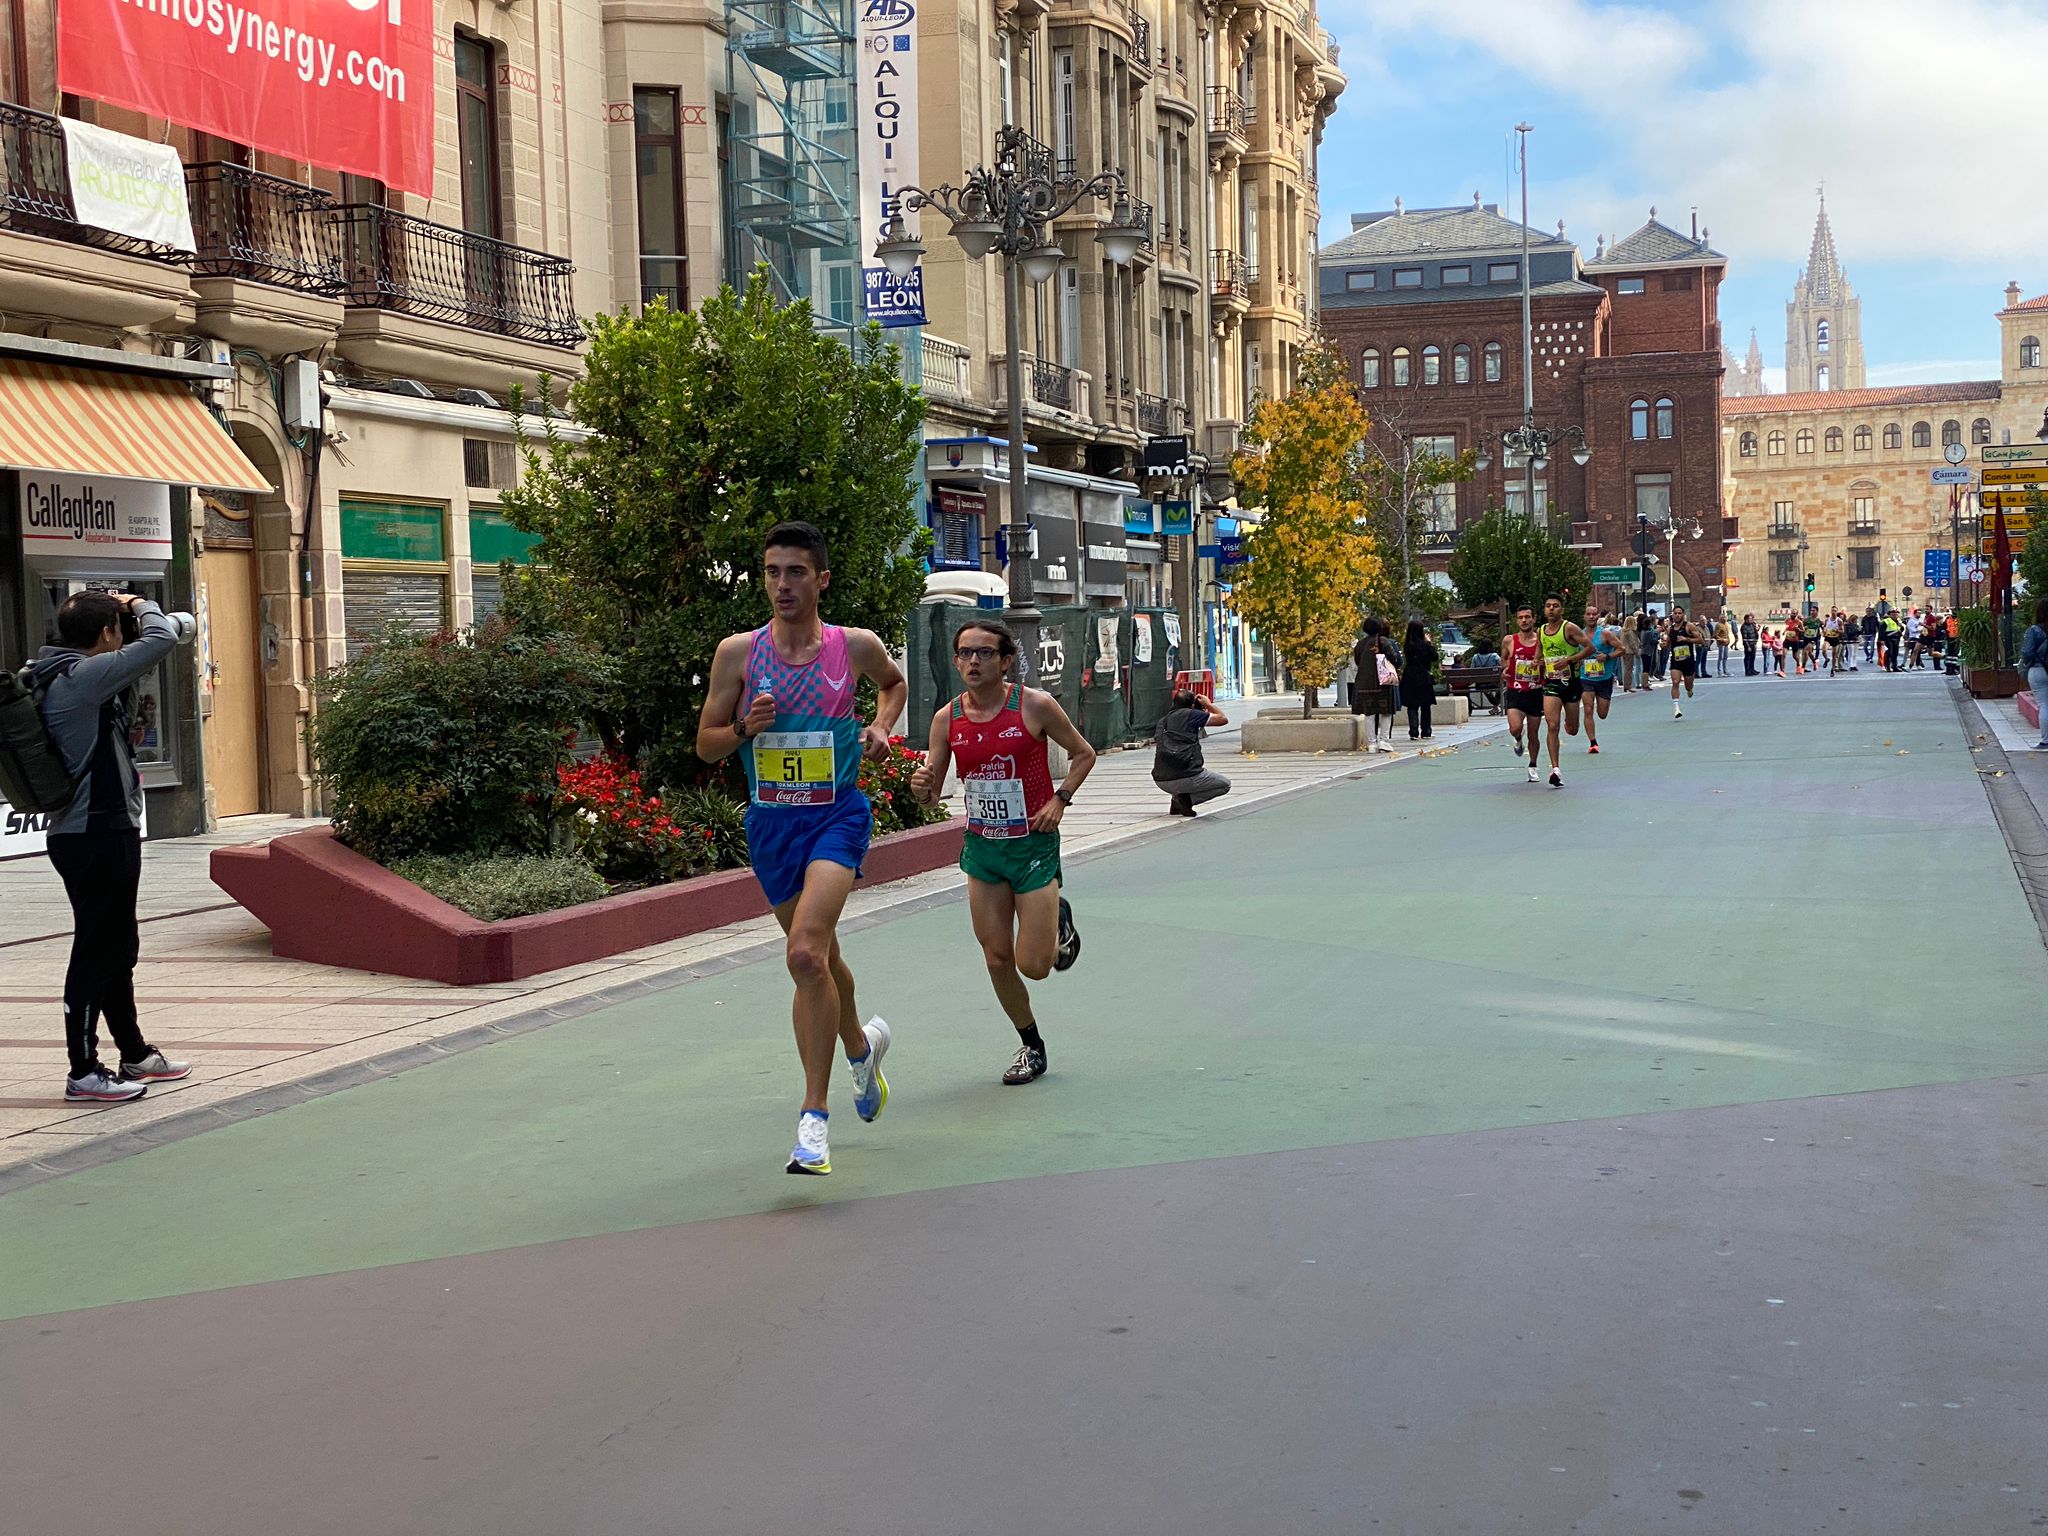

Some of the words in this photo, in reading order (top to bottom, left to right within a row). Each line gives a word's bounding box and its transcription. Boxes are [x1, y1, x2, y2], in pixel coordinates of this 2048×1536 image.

[866, 272, 883, 288] 987
[866, 287, 921, 309] LEÓN
[1933, 470, 1968, 480] Cámara
[2006, 518, 2023, 526] San
[783, 757, 802, 782] 51
[981, 762, 1005, 771] Patria
[978, 800, 1009, 820] 399
